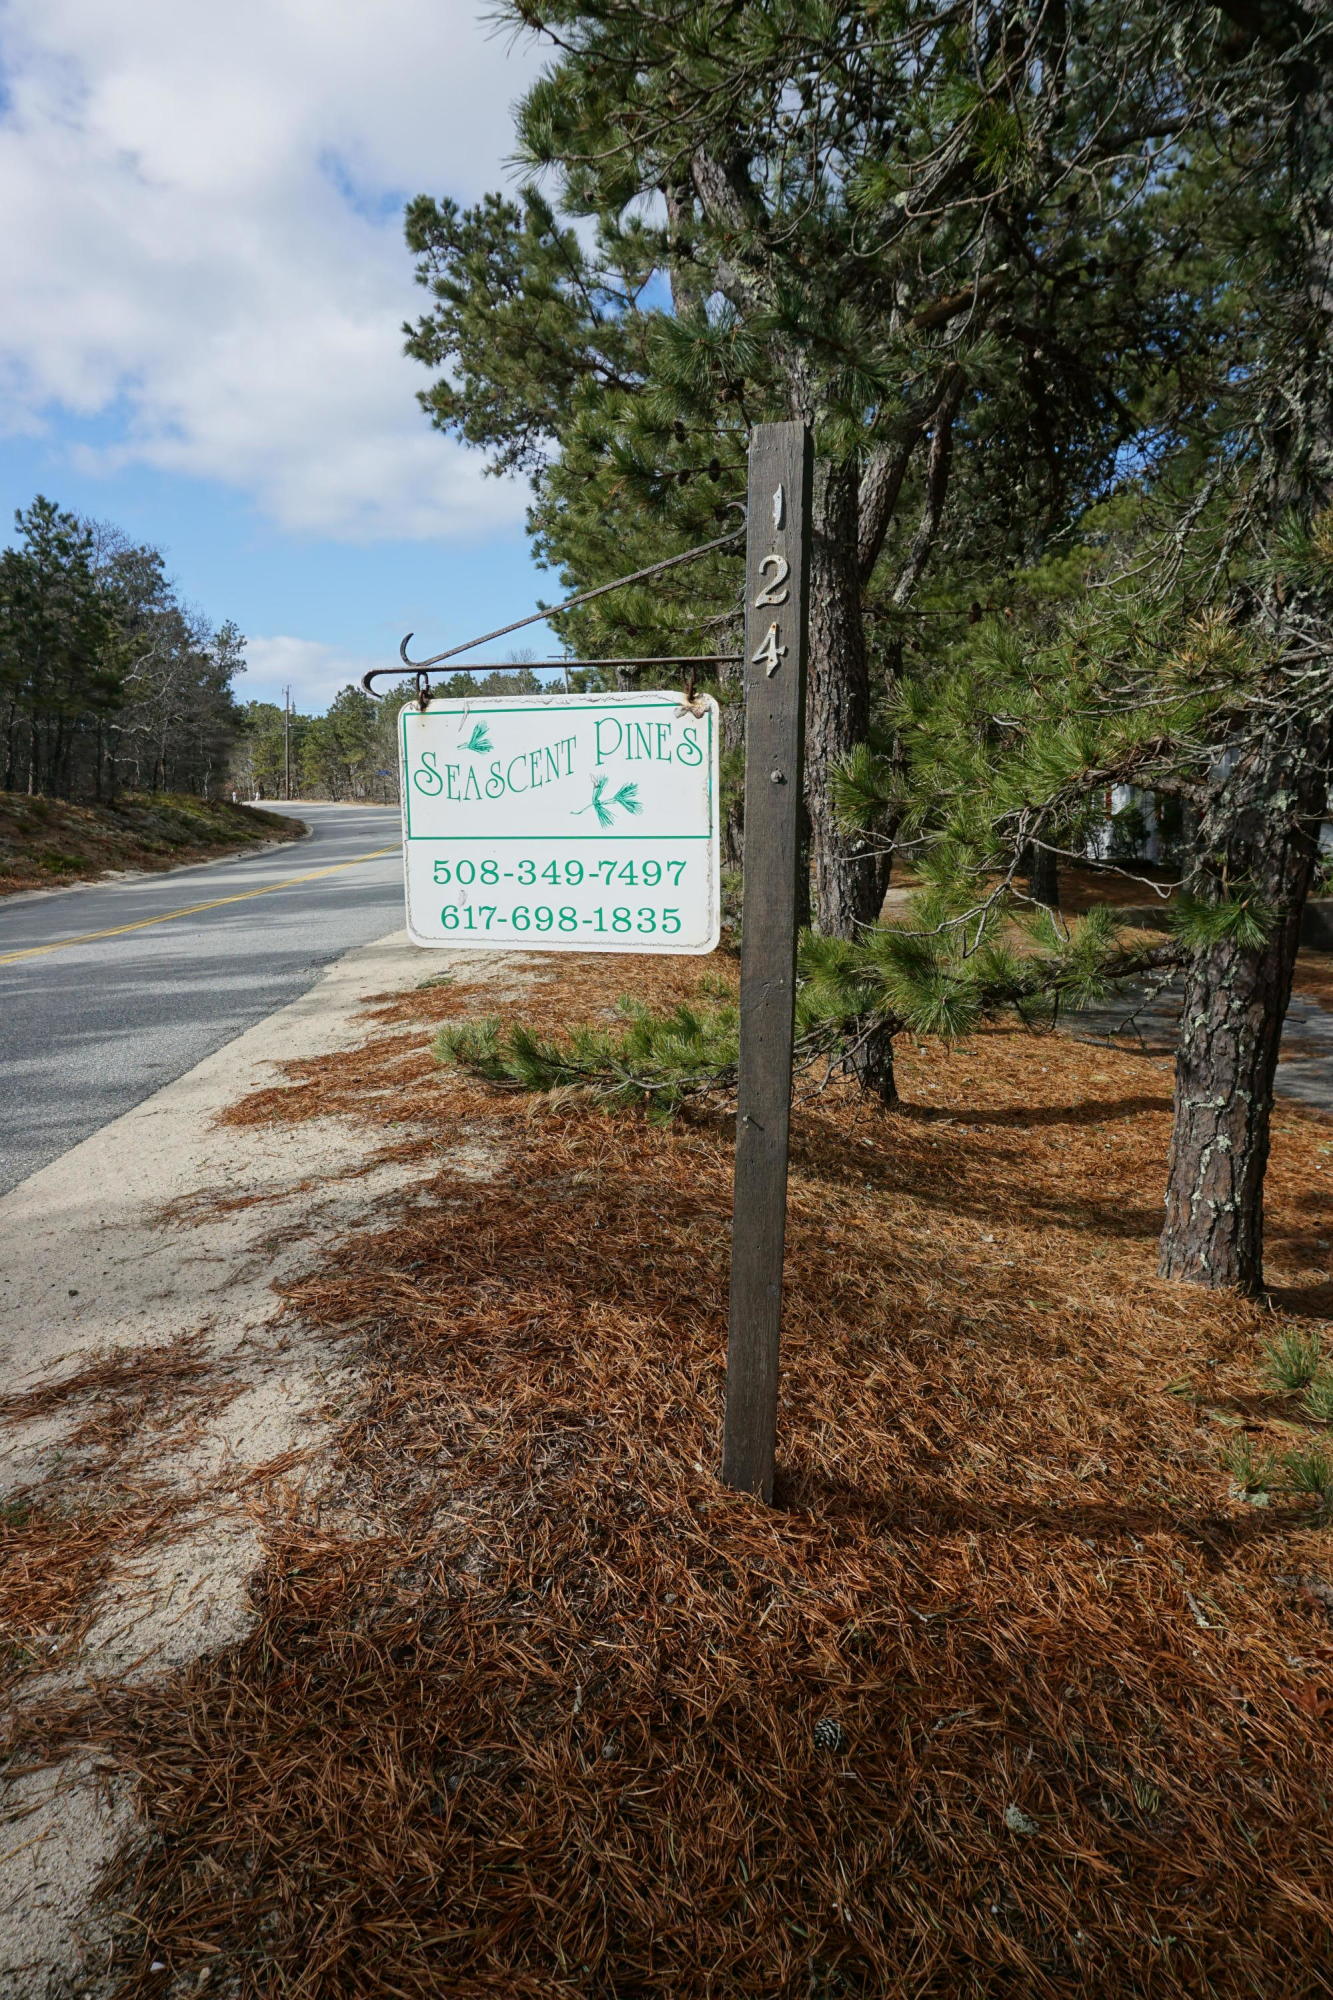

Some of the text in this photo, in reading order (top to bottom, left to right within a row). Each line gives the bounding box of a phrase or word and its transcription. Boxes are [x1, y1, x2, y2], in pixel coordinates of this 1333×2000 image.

[752, 483, 788, 677] 124
[413, 717, 703, 801] SEASCENT PINES
[433, 860, 687, 886] 508-349-7497
[440, 905, 682, 934] 617-698-1835
